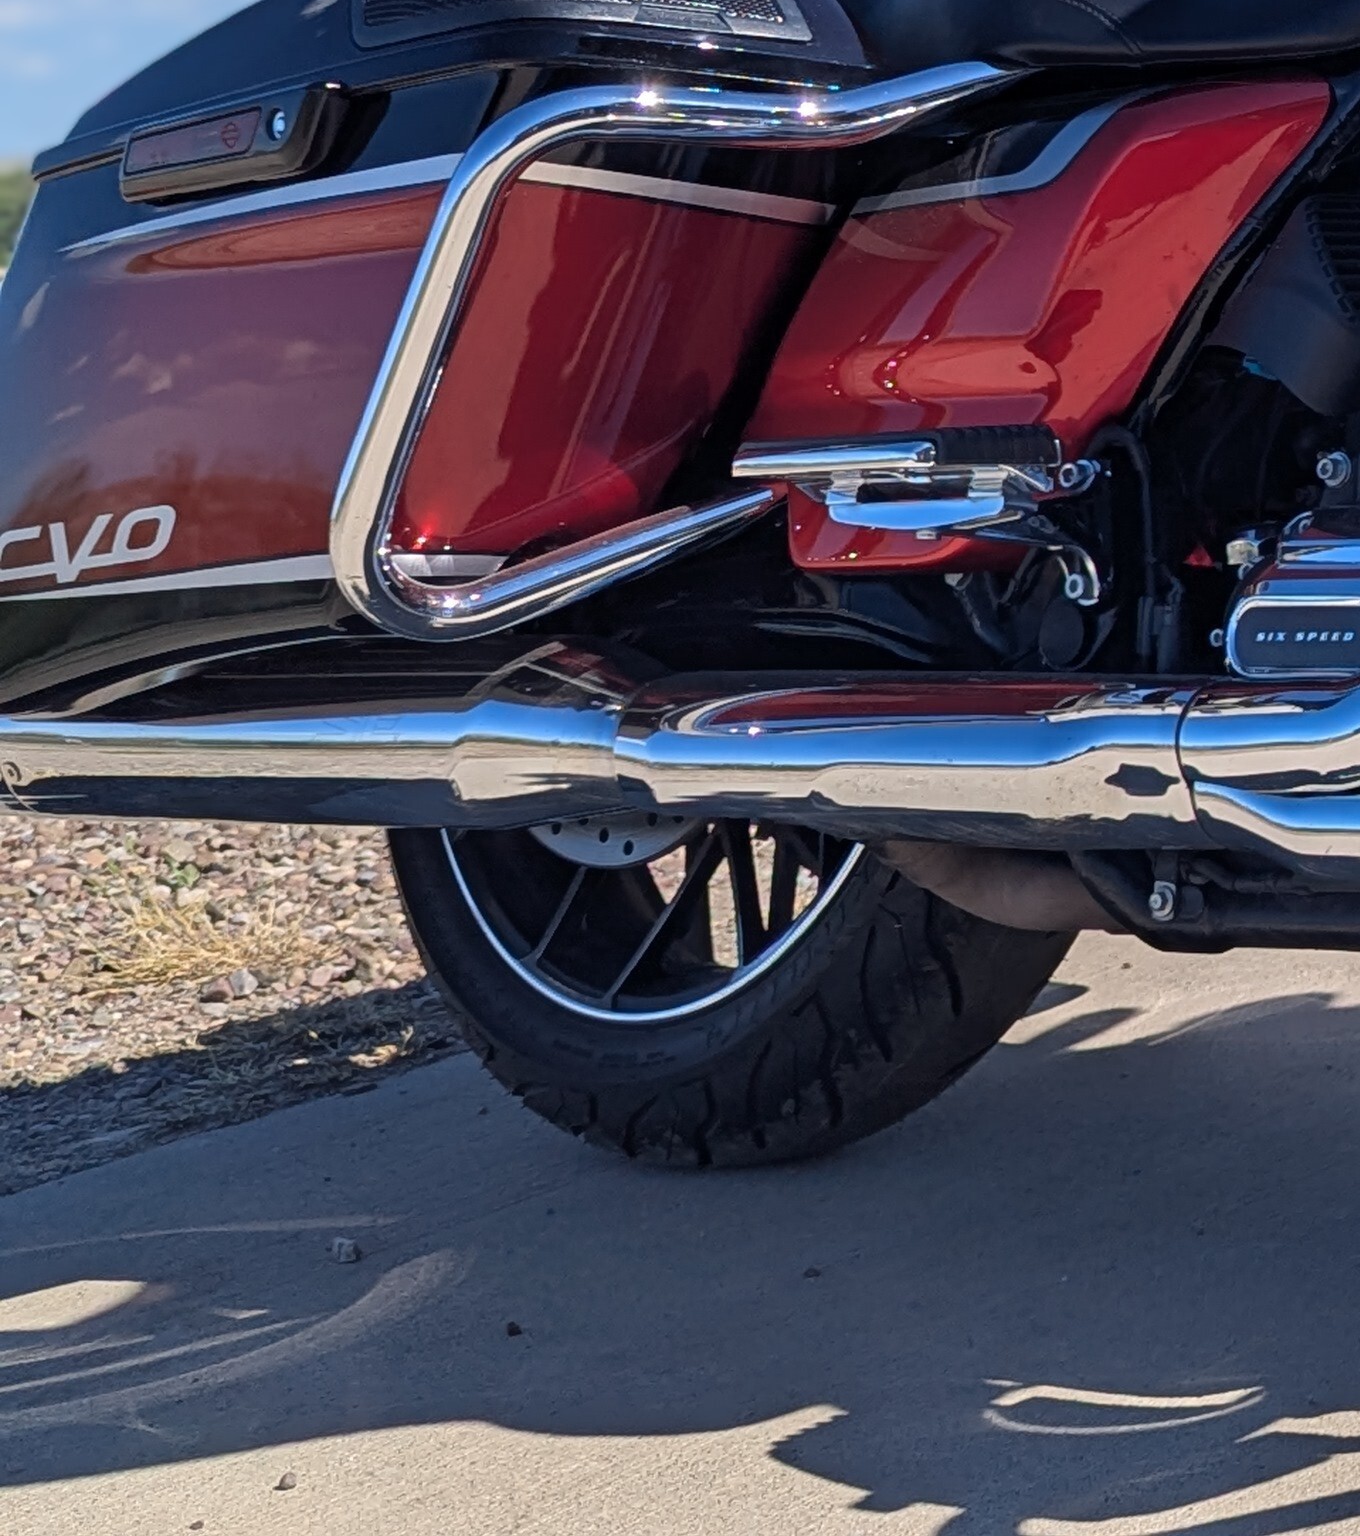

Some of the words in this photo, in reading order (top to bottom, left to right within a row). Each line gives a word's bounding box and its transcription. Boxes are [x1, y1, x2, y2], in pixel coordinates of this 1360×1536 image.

[0, 504, 177, 583] CVO
[1255, 631, 1287, 642] SIX
[1294, 631, 1356, 642] SPEED
